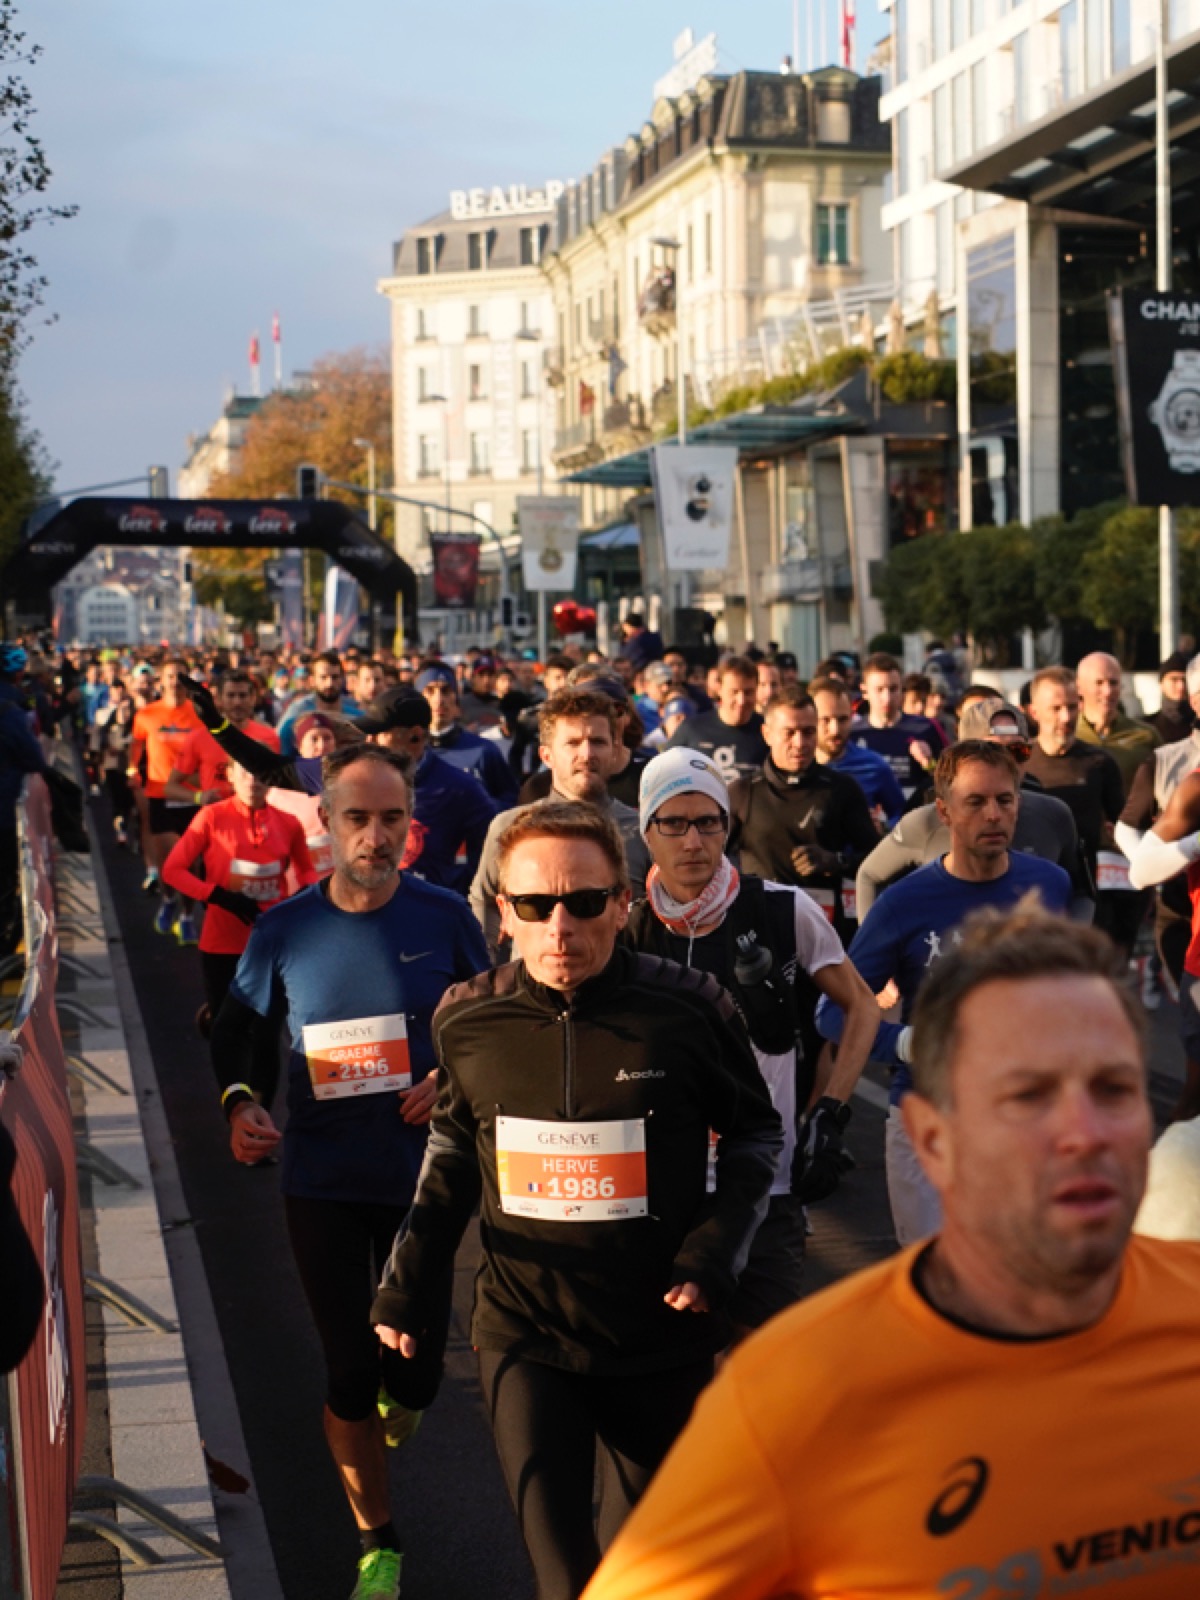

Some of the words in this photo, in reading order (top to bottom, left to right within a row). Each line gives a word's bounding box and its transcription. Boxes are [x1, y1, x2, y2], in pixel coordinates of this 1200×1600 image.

[329, 1043, 383, 1062] GRAEME
[339, 1057, 390, 1081] 2196
[542, 1157, 600, 1174] HERVE
[547, 1176, 616, 1199] 1986
